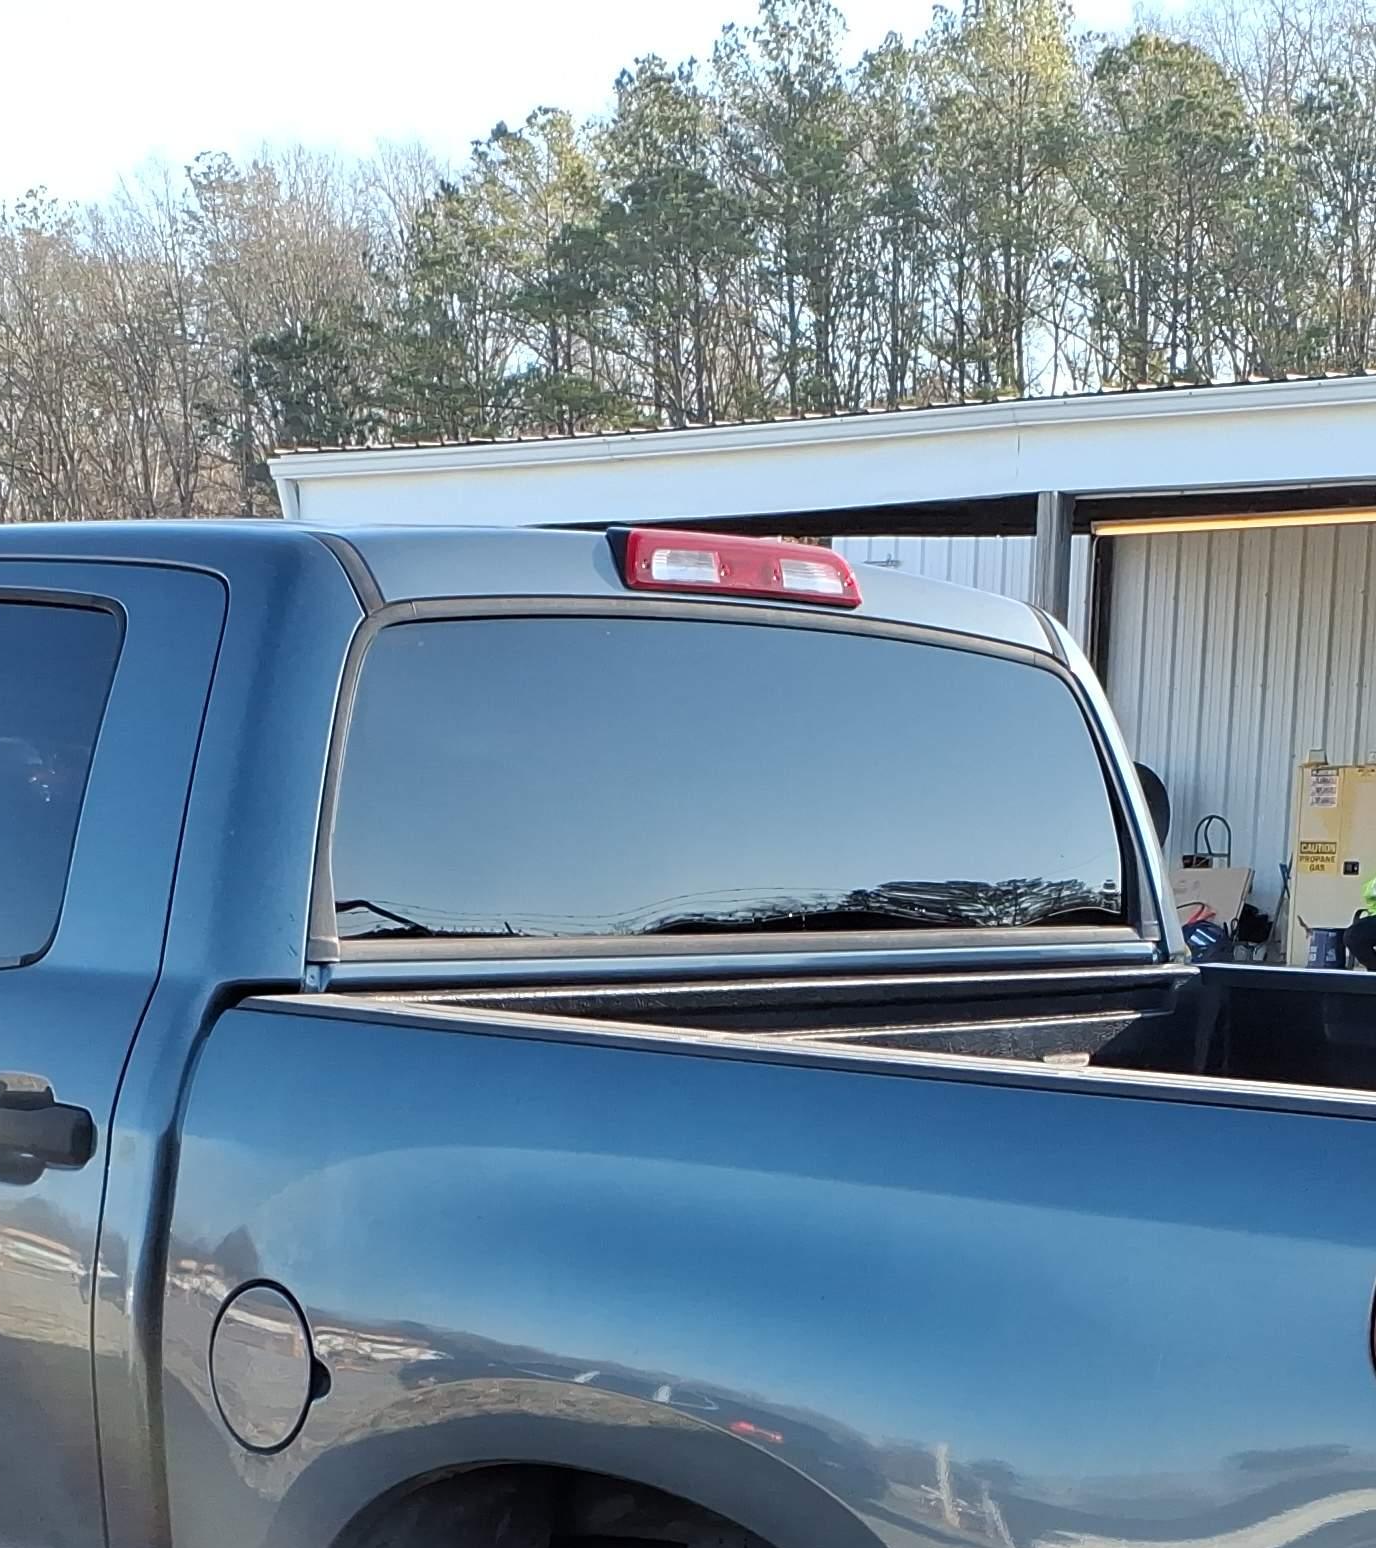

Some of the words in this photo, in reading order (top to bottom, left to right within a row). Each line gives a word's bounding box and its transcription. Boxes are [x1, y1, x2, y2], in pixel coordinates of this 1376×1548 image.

[1301, 843, 1336, 853] CAUTION
[1299, 855, 1335, 864] PROPANE
[1309, 864, 1326, 872] GAS
